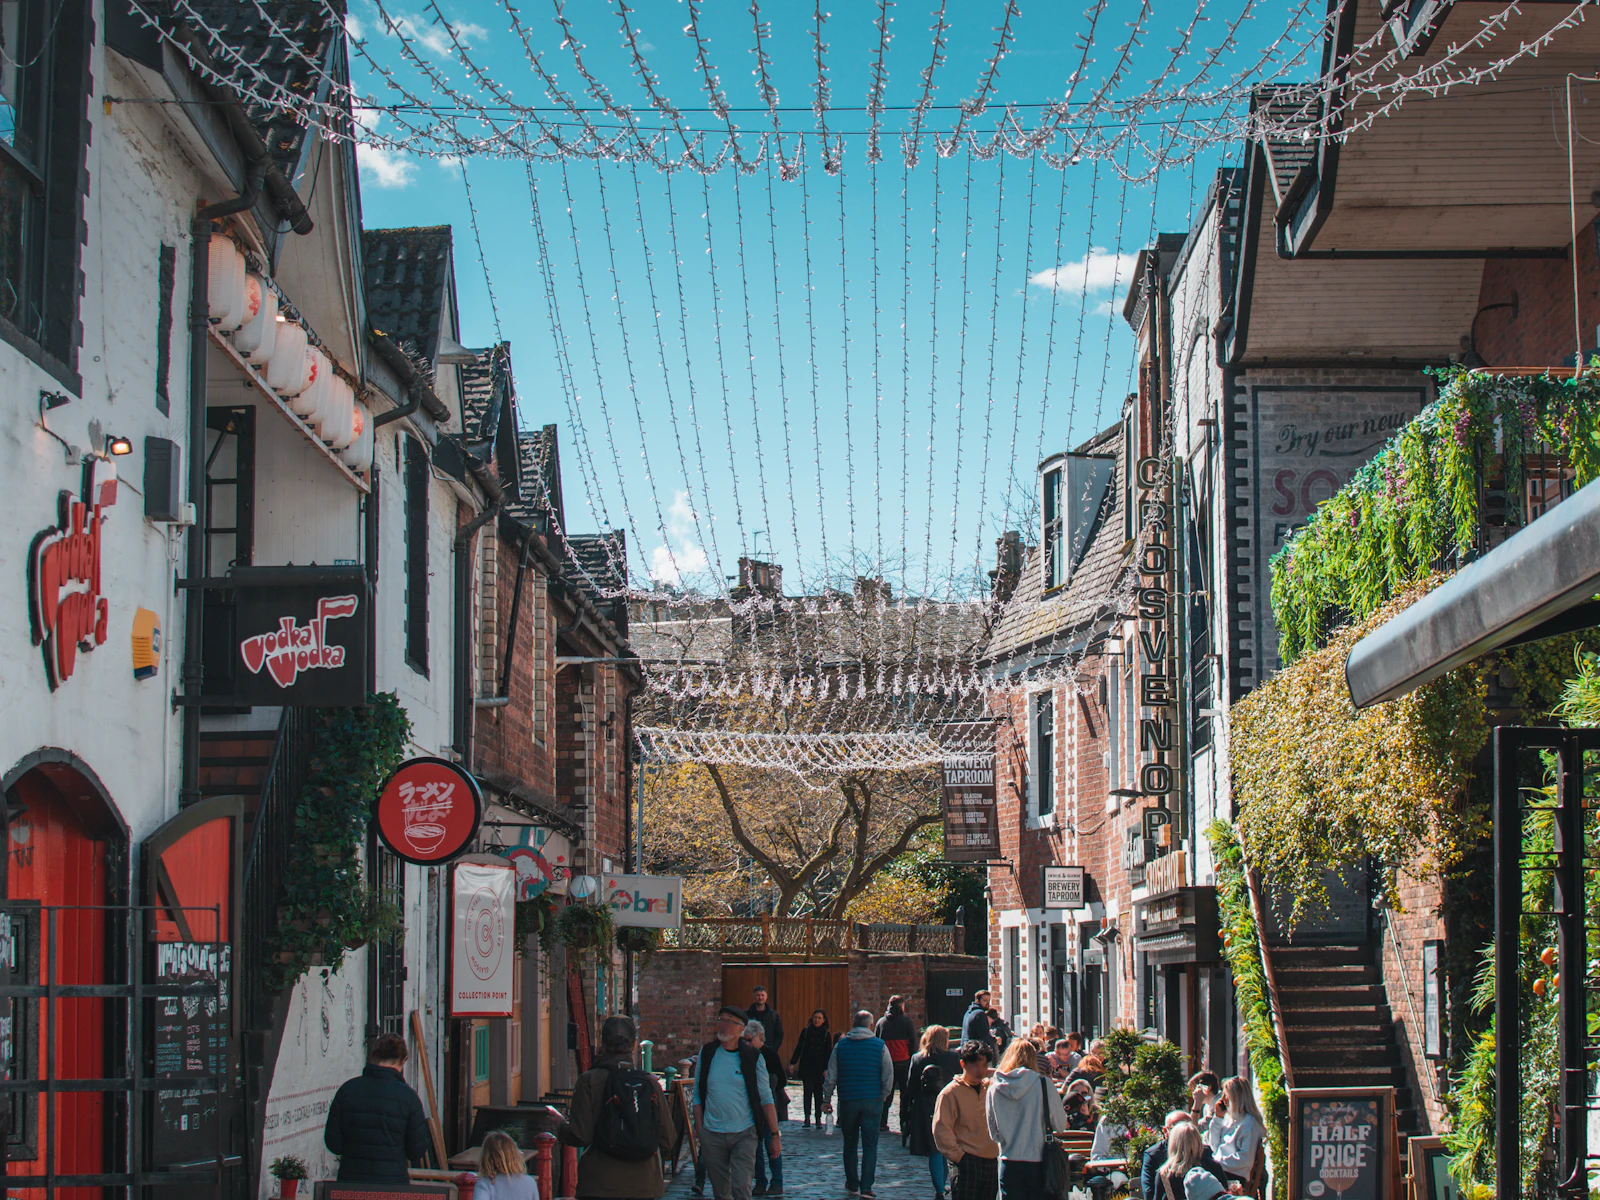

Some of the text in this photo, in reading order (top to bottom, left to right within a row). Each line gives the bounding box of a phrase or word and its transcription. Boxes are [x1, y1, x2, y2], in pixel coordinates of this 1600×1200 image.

[1275, 412, 1406, 458] Try our new
[945, 756, 992, 769] BREWERY
[944, 770, 993, 783] TAPROOM
[399, 781, 455, 804] ラーメン
[1048, 882, 1080, 890] BREWERY
[634, 890, 673, 913] brel
[1048, 892, 1080, 900] TAPROOM
[1311, 1125, 1371, 1141] HALF
[1311, 1144, 1366, 1167] PRICE
[1320, 1168, 1359, 1178] COCKTAILS
